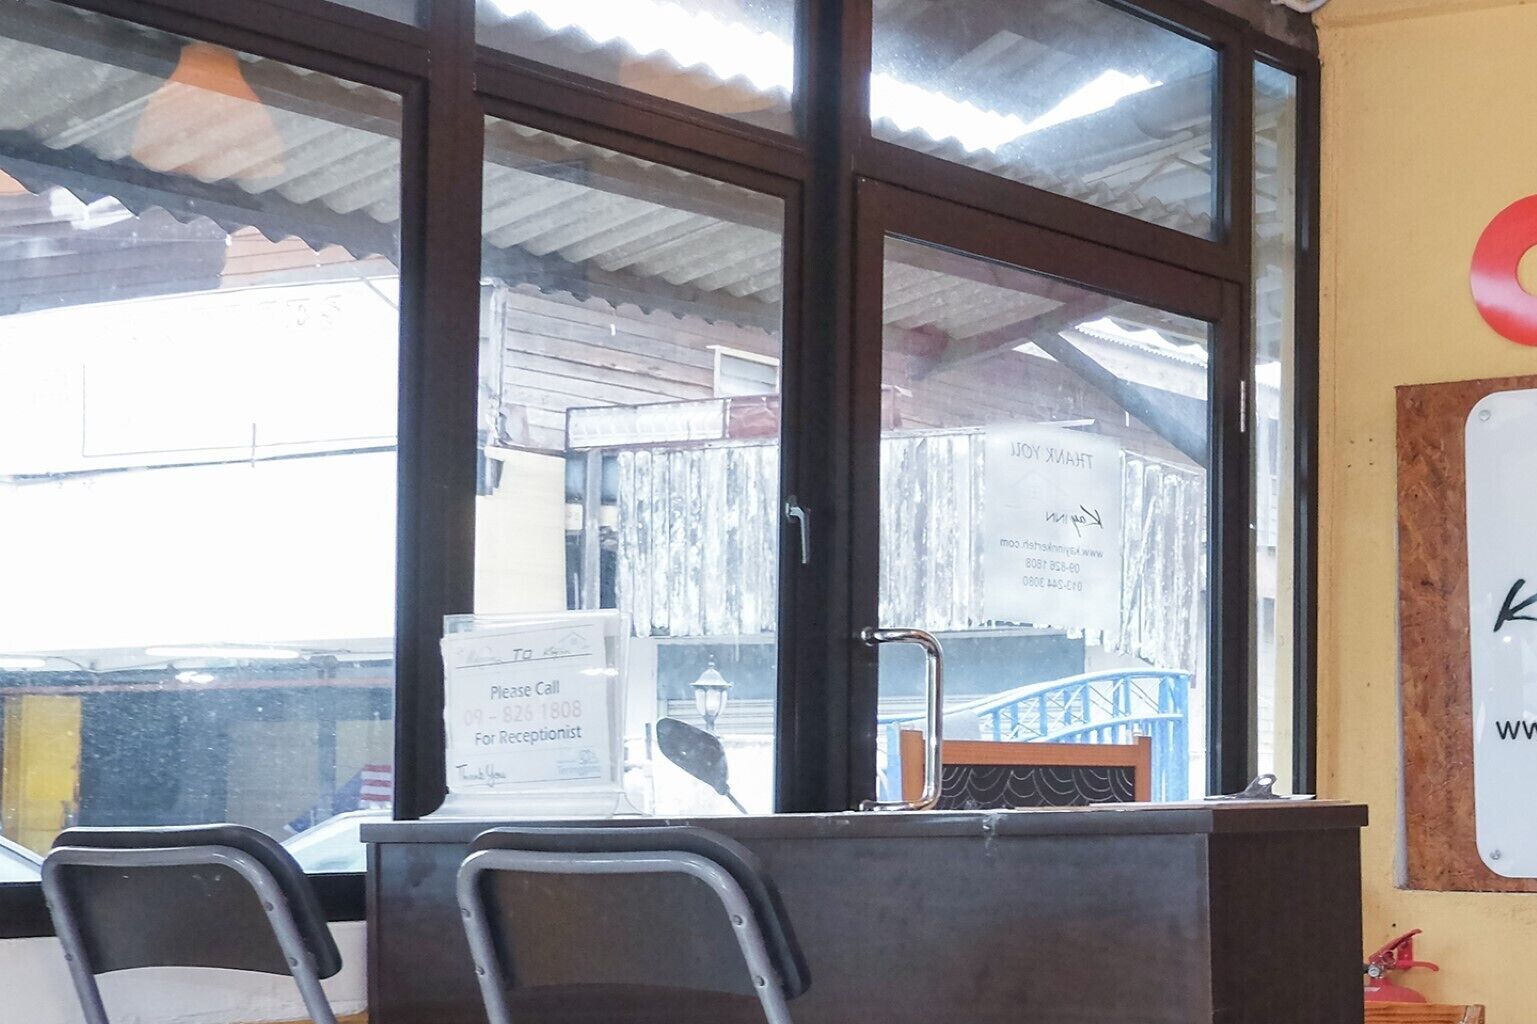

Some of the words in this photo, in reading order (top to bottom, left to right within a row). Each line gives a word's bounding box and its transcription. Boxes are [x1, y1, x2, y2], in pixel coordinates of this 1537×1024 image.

[490, 682, 532, 700] Please
[535, 680, 560, 695] Call
[503, 704, 533, 723] 826
[542, 700, 582, 719] 1808
[475, 732, 496, 746] For
[500, 725, 582, 746] Receptionist
